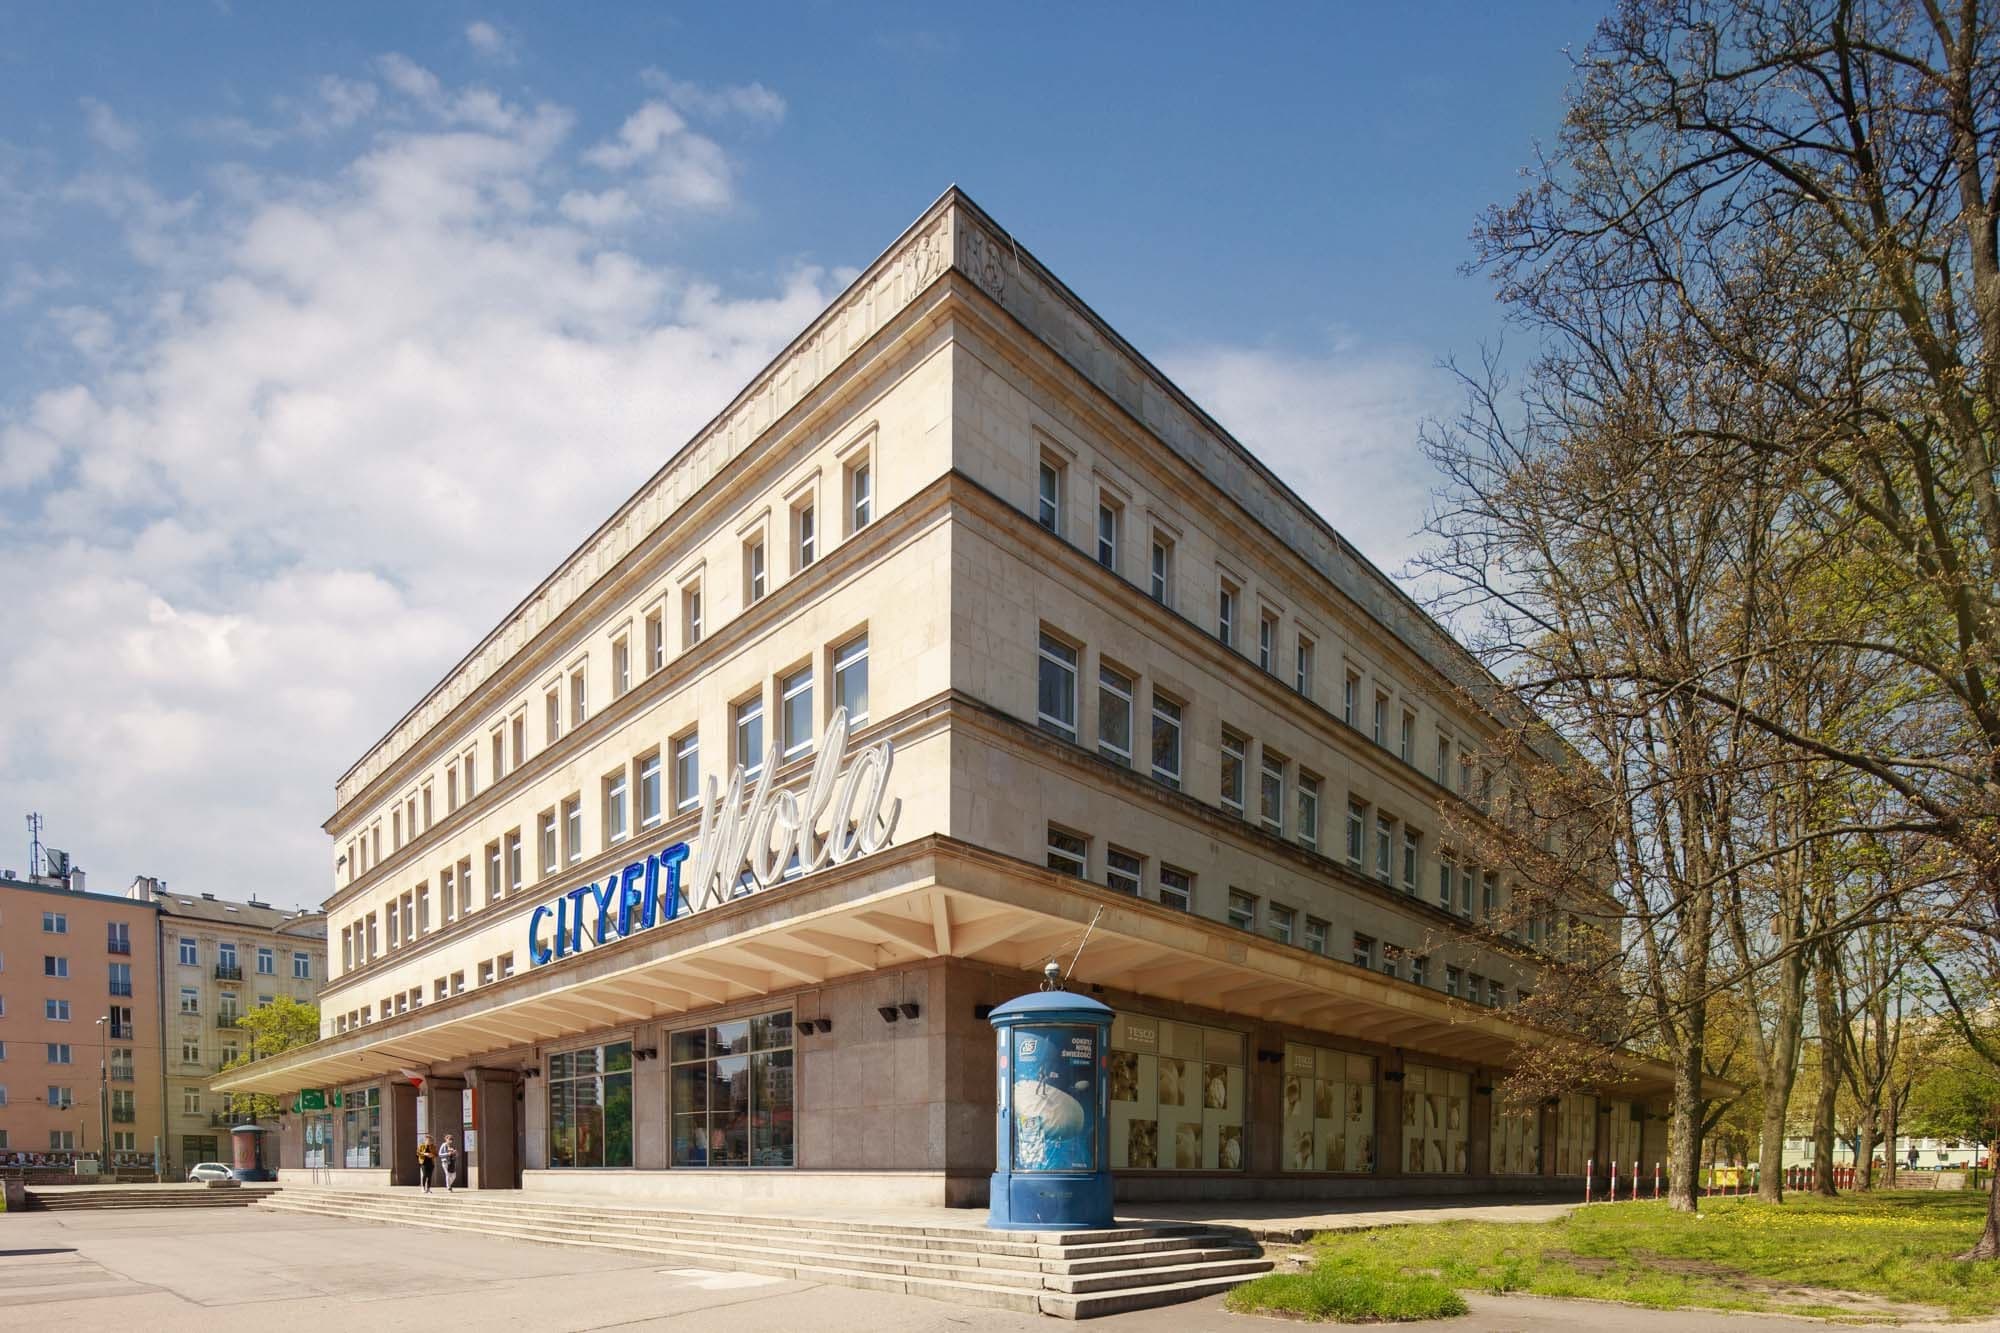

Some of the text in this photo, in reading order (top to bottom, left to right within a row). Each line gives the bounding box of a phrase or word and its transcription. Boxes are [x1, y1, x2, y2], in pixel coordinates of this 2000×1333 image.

[529, 705, 902, 965] CITYFIT Wola
[1128, 1026, 1154, 1039] TESCO
